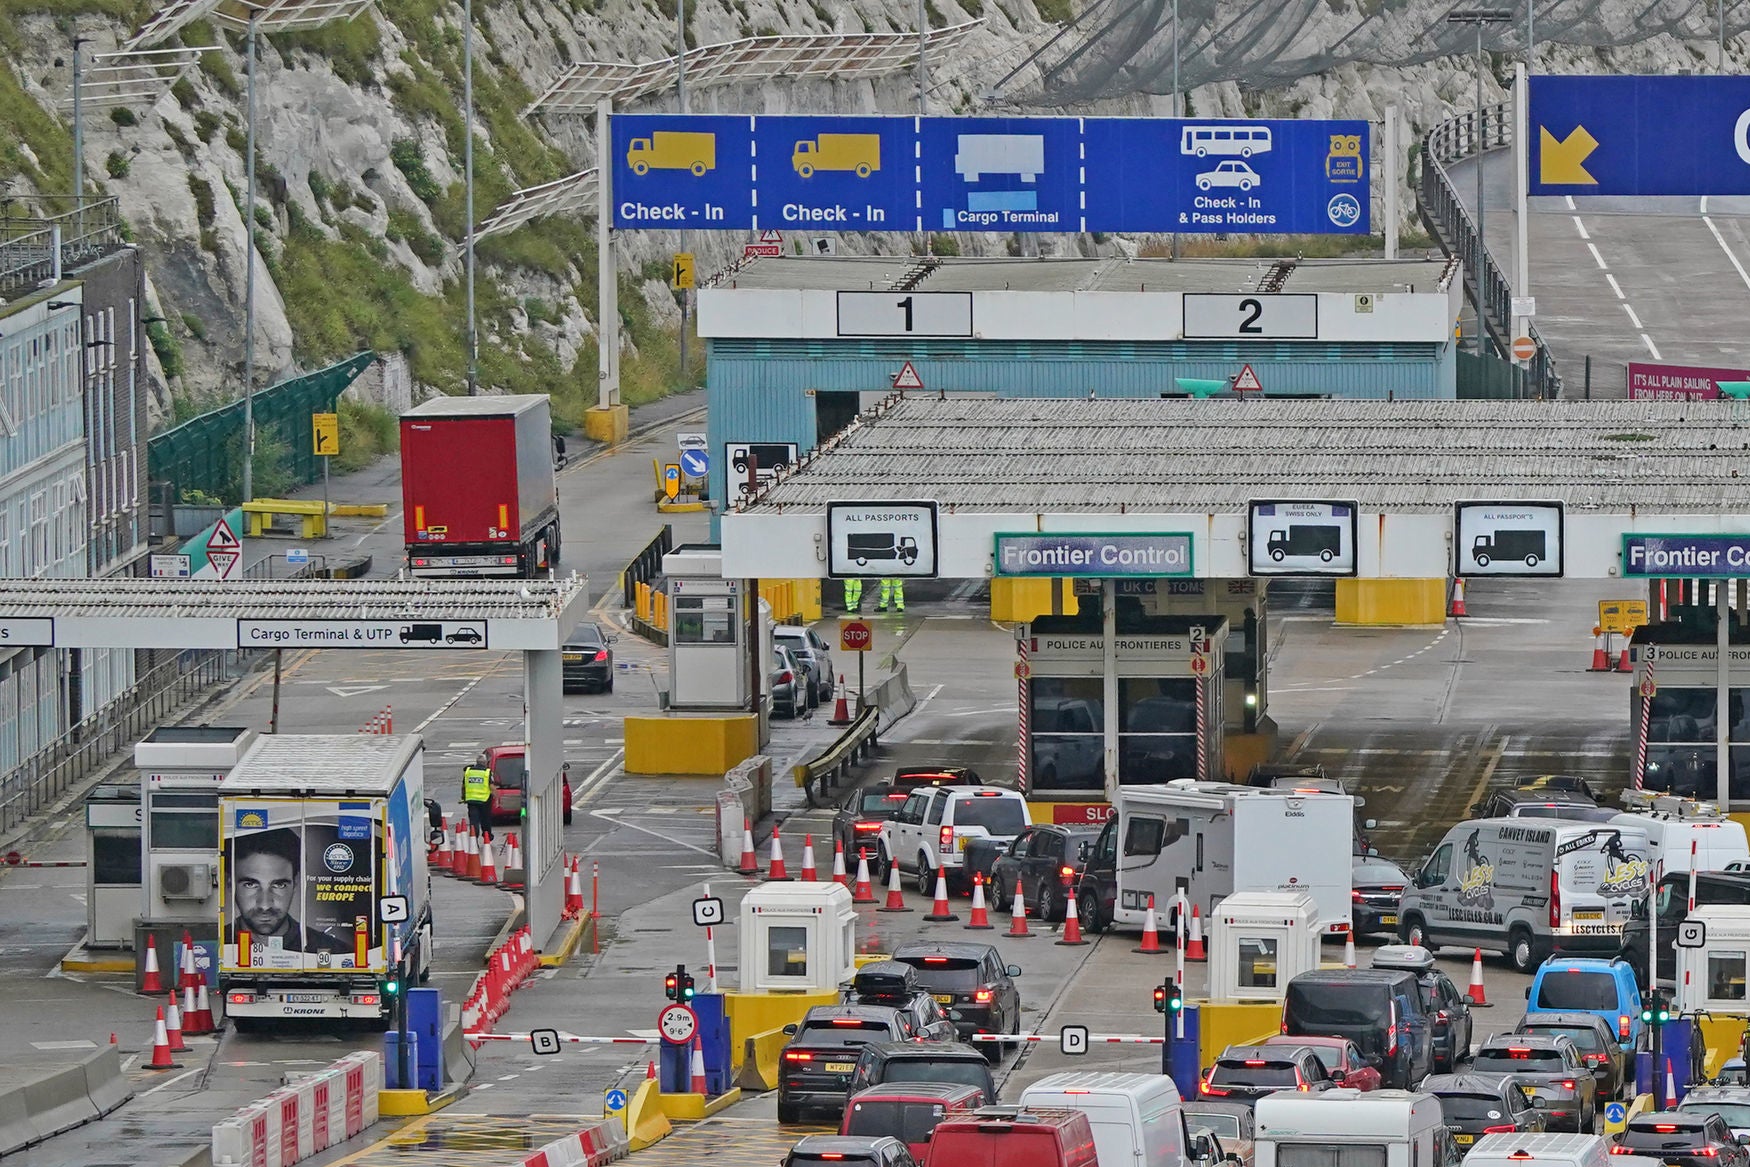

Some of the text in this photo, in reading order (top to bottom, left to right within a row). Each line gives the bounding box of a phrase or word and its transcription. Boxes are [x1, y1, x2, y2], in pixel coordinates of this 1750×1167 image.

[1194, 197, 1236, 208] Check
[1248, 198, 1261, 208] In
[620, 202, 685, 221] Check
[706, 203, 724, 220] In
[782, 204, 846, 222] Check
[867, 204, 885, 222] In
[958, 210, 1059, 226] Cargo Terminal
[1179, 212, 1276, 224] & Pass Holders
[897, 296, 912, 331] 1
[1238, 299, 1262, 334] 2
[1634, 374, 1710, 390] IT'S ALL PLAIN SAILING
[1004, 544, 1186, 567] Frontier Control
[1630, 545, 1720, 567] Frontier
[250, 626, 392, 643] Cargo Terminal & UTP
[844, 631, 869, 640] STOP
[1018, 626, 1026, 638] 1
[1192, 628, 1202, 640] 2
[1047, 640, 1182, 650] POLICE AU FRONTIERES
[1647, 648, 1655, 659] 3
[1659, 650, 1696, 660] POLICE
[1499, 827, 1550, 843] CANVEY ISLAND
[333, 884, 373, 892] connect
[316, 892, 355, 901] EUROPE
[388, 904, 400, 914] A
[702, 907, 714, 916] C
[1685, 929, 1697, 939] G
[253, 943, 263, 952] 80
[253, 957, 264, 966] 60
[319, 954, 329, 962] 90
[668, 1013, 689, 1021] 2.9m
[541, 1037, 550, 1047] B
[1070, 1035, 1080, 1046] D
